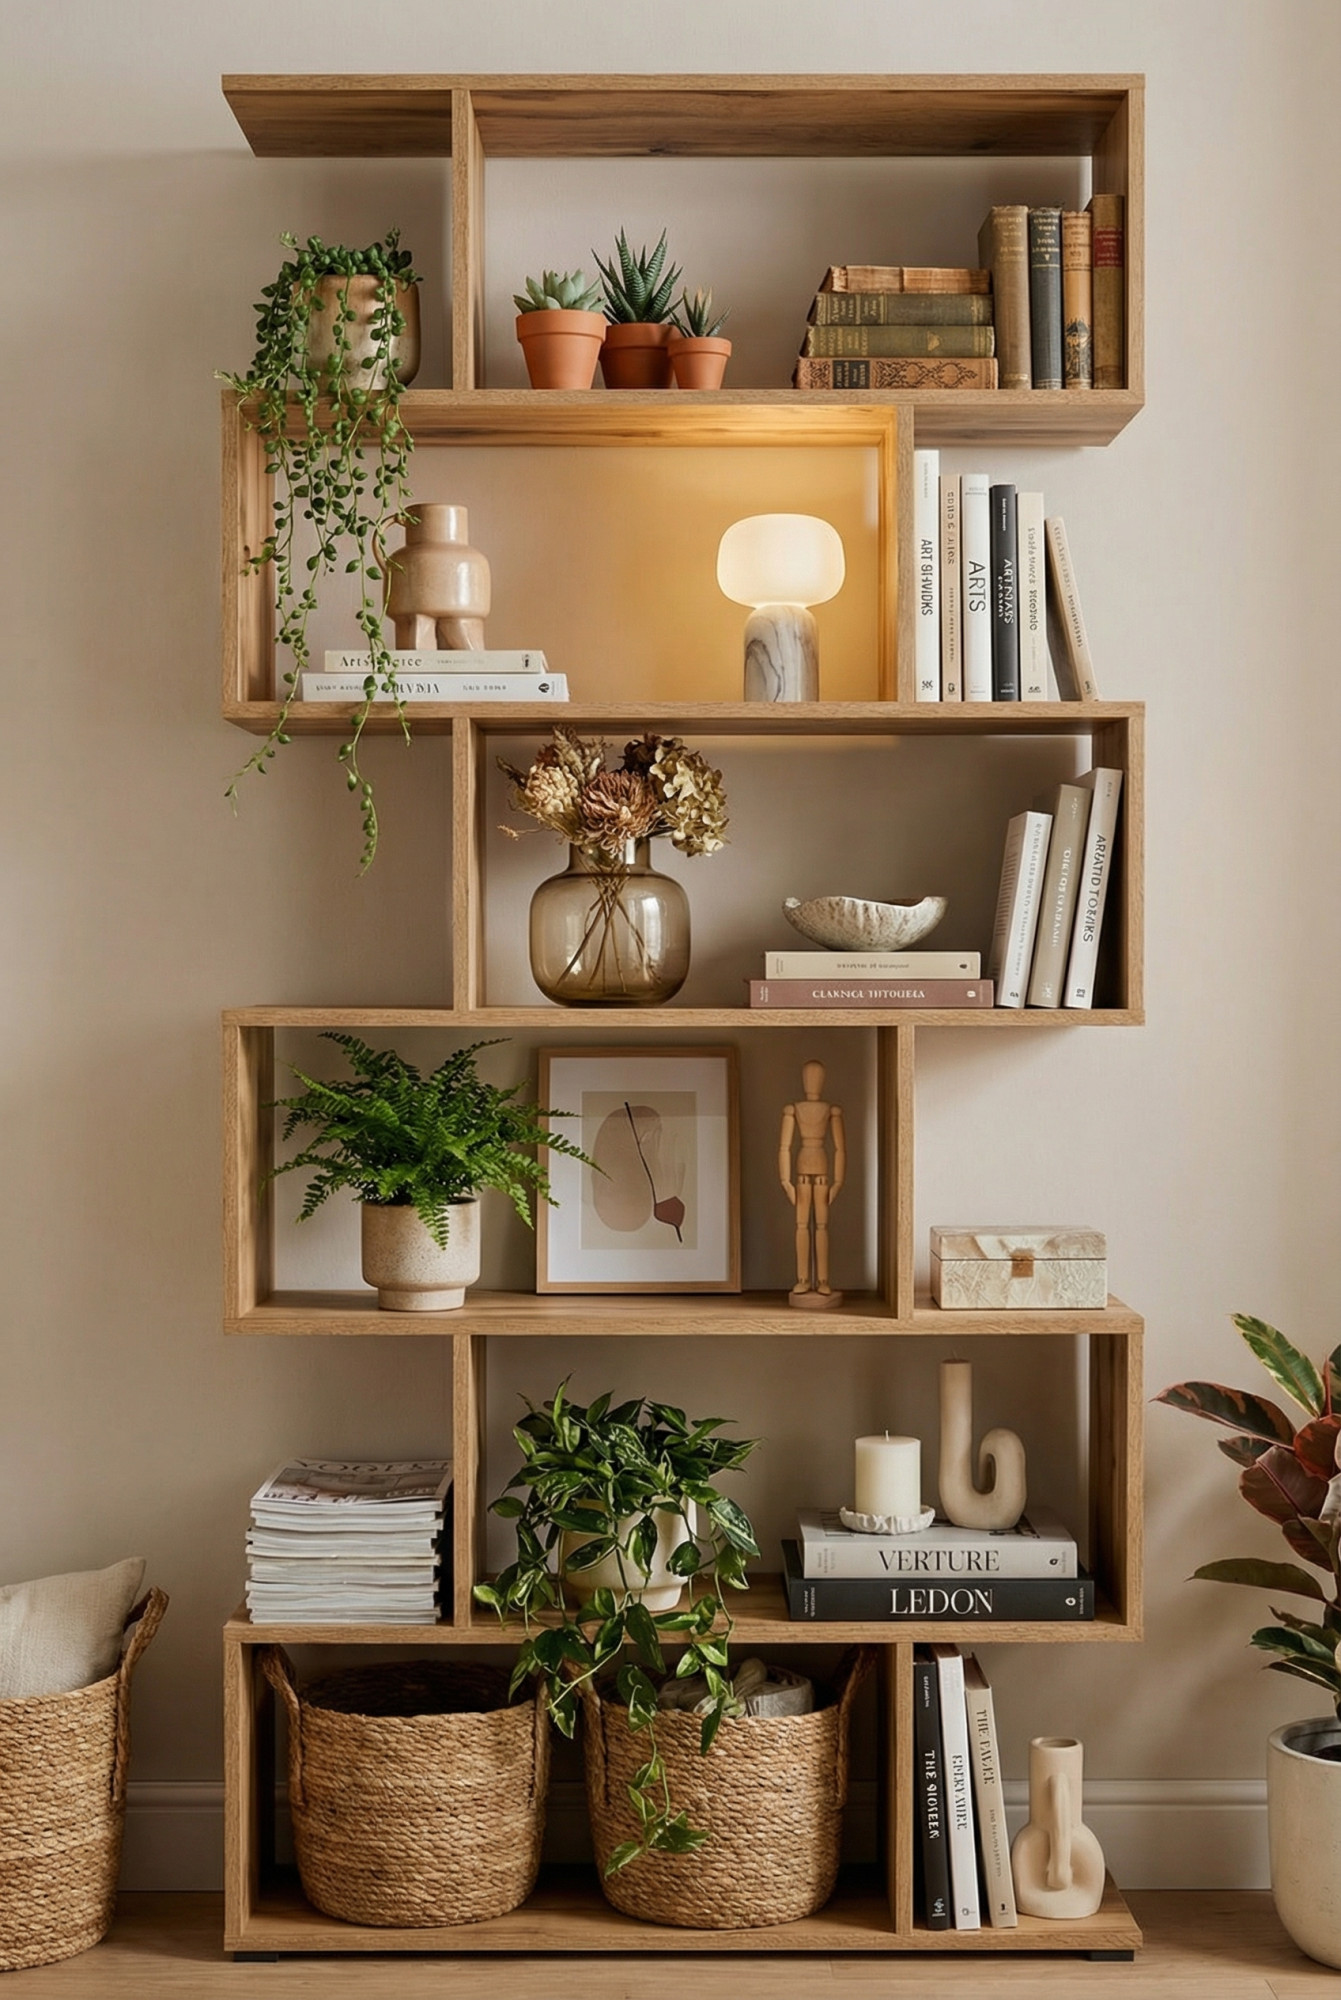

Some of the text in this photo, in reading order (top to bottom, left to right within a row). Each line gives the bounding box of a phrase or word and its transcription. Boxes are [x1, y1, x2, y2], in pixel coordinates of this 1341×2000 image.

[920, 538, 933, 562] ART
[968, 560, 987, 613] ARTS
[877, 1549, 1000, 1573] VERTURE
[889, 1587, 994, 1615] LEDON
[923, 1749, 938, 1780] THE
